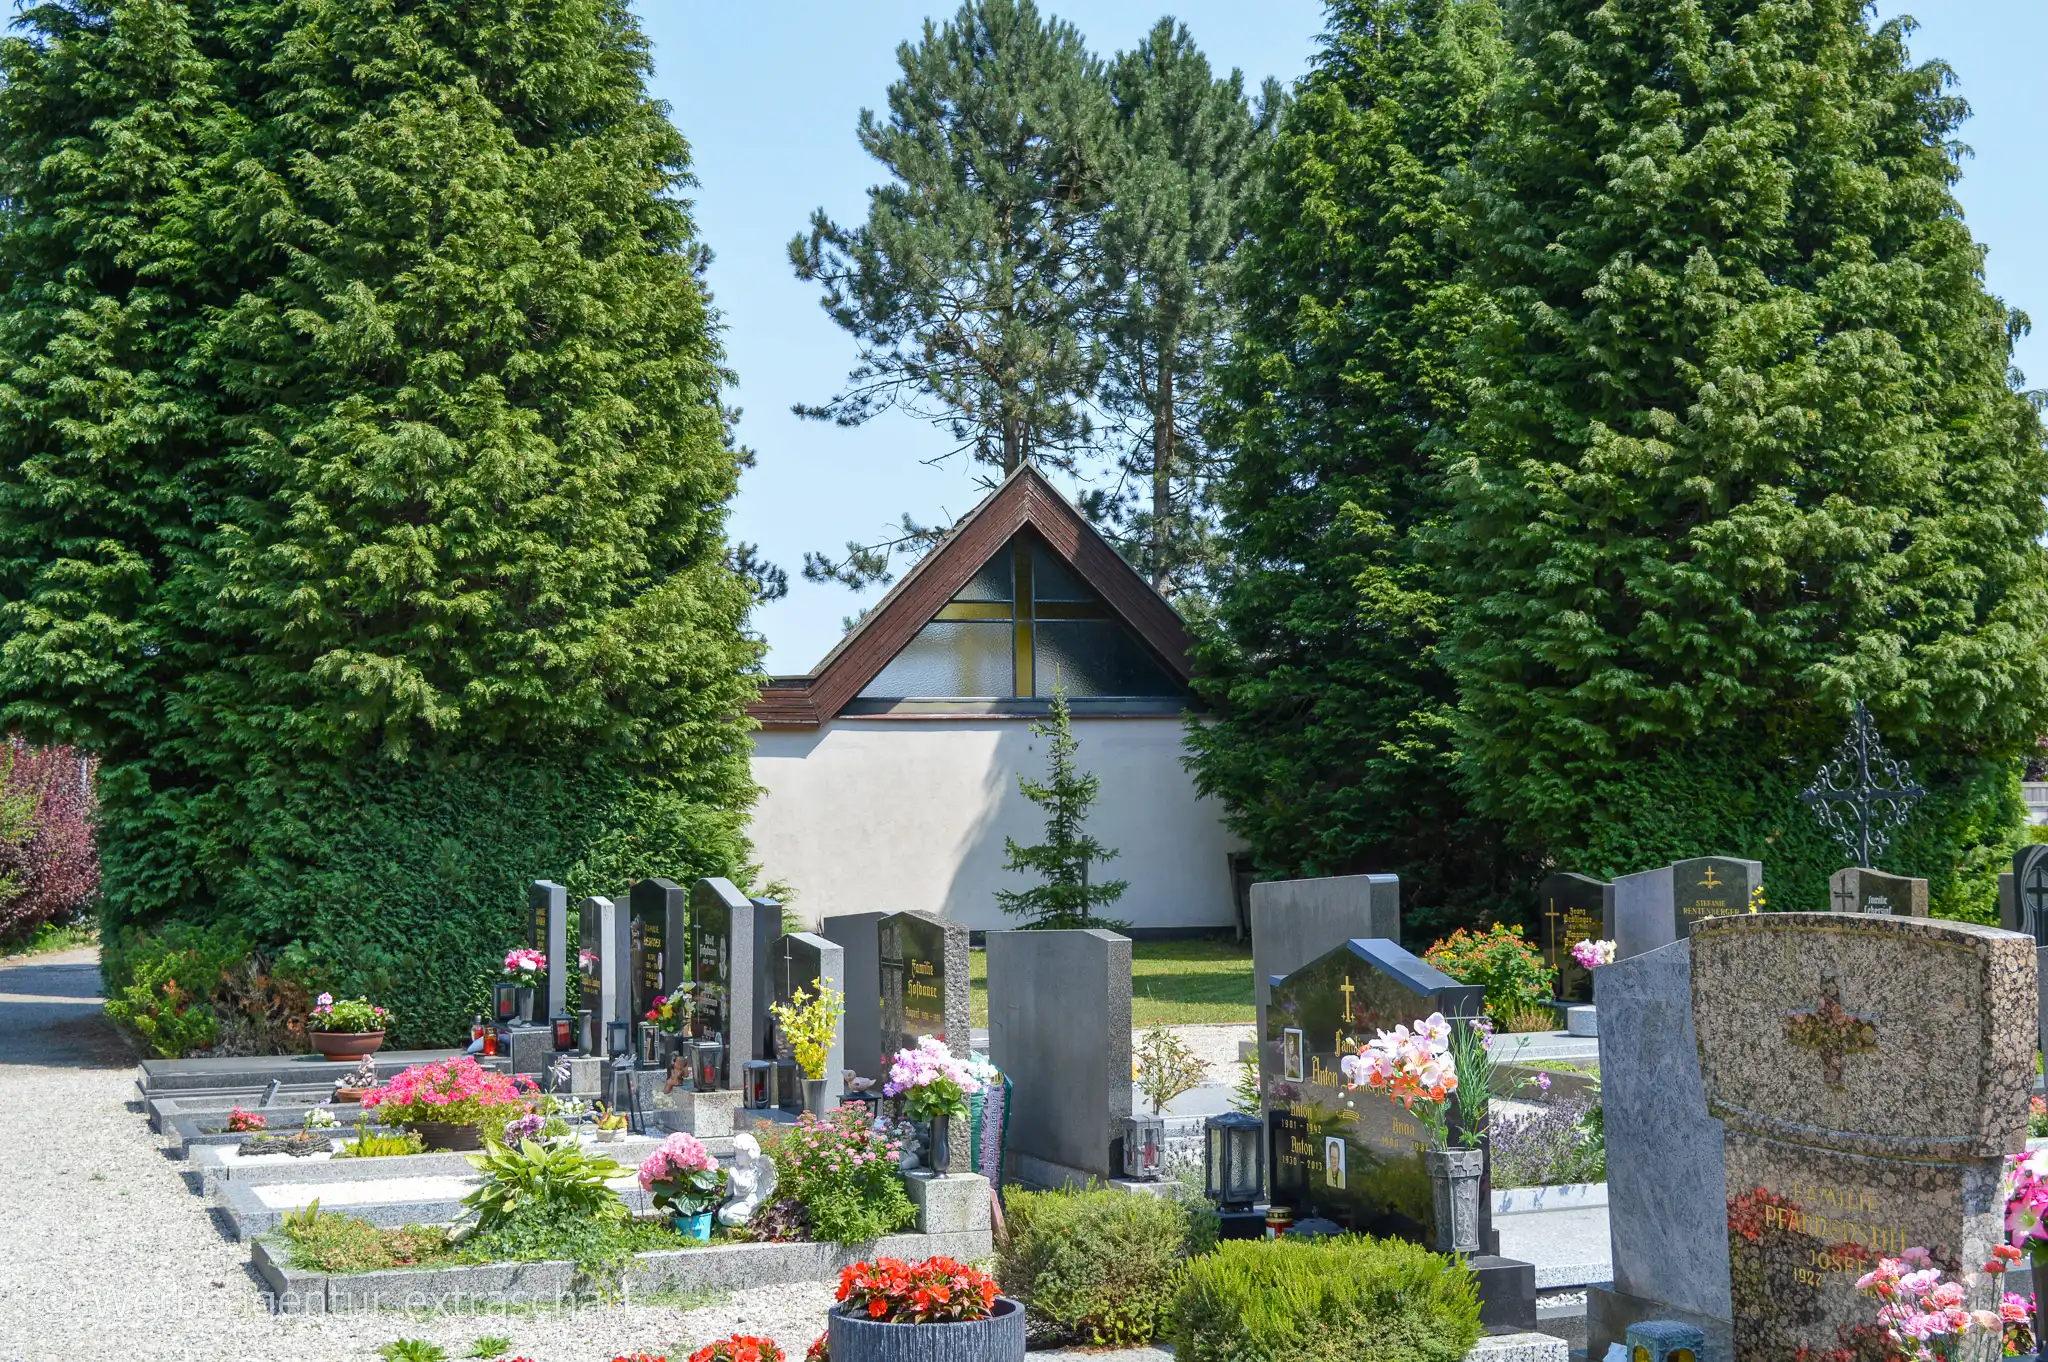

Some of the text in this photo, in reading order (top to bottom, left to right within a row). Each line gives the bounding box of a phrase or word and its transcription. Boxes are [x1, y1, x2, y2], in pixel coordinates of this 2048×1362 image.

[911, 958, 934, 979] Familie
[907, 979, 938, 999] Hofbauer
[1311, 1055, 1339, 1087] Anton
[1290, 1102, 1313, 1119] Anton
[1306, 1123, 1322, 1134] 1942
[1393, 1117, 1415, 1136] Anna
[1291, 1136, 1313, 1156] Anton
[1282, 1155, 1297, 1166] 1930
[1307, 1161, 1323, 1172] 2013
[1793, 1183, 1881, 1213] FAMILIE
[1807, 1249, 1868, 1277] JOSEF
[1793, 1267, 1823, 1288] 1927
